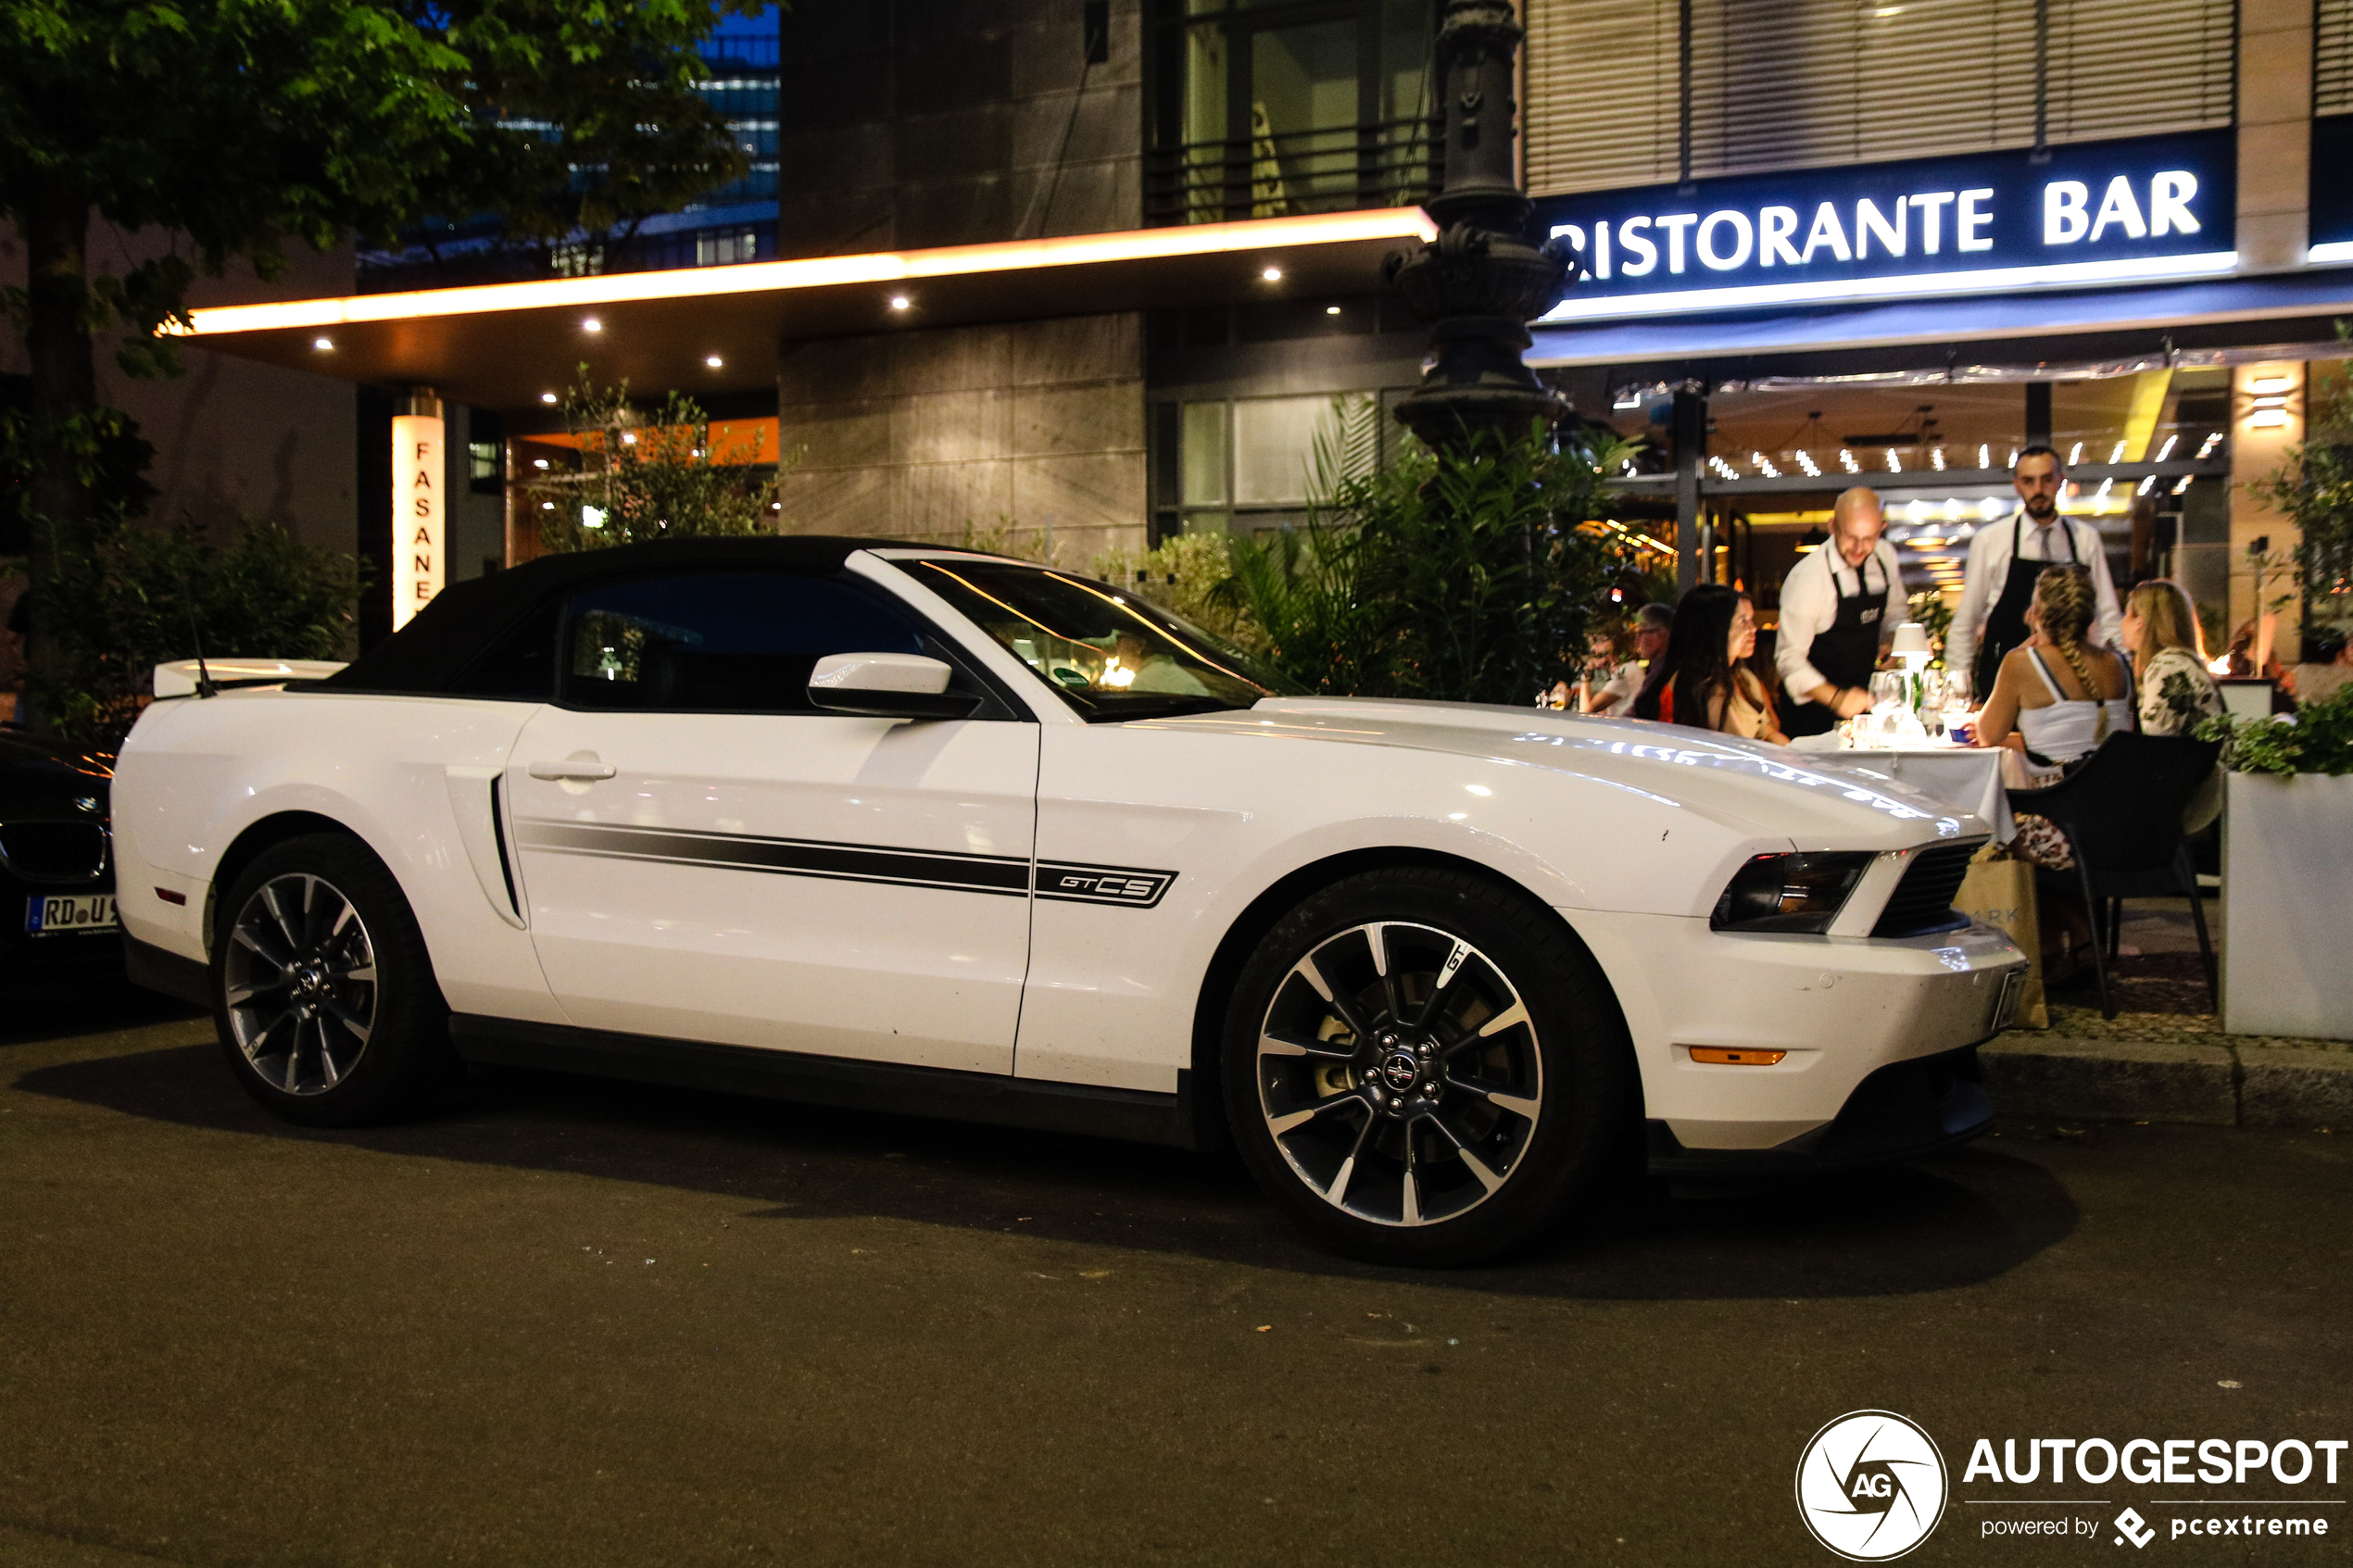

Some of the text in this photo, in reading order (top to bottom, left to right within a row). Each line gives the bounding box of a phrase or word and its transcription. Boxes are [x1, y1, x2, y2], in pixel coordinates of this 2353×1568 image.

[2044, 169, 2202, 245] BAR
[415, 443, 432, 613] FASANE
[45, 899, 75, 925] RD
[1447, 945, 1464, 972] GT
